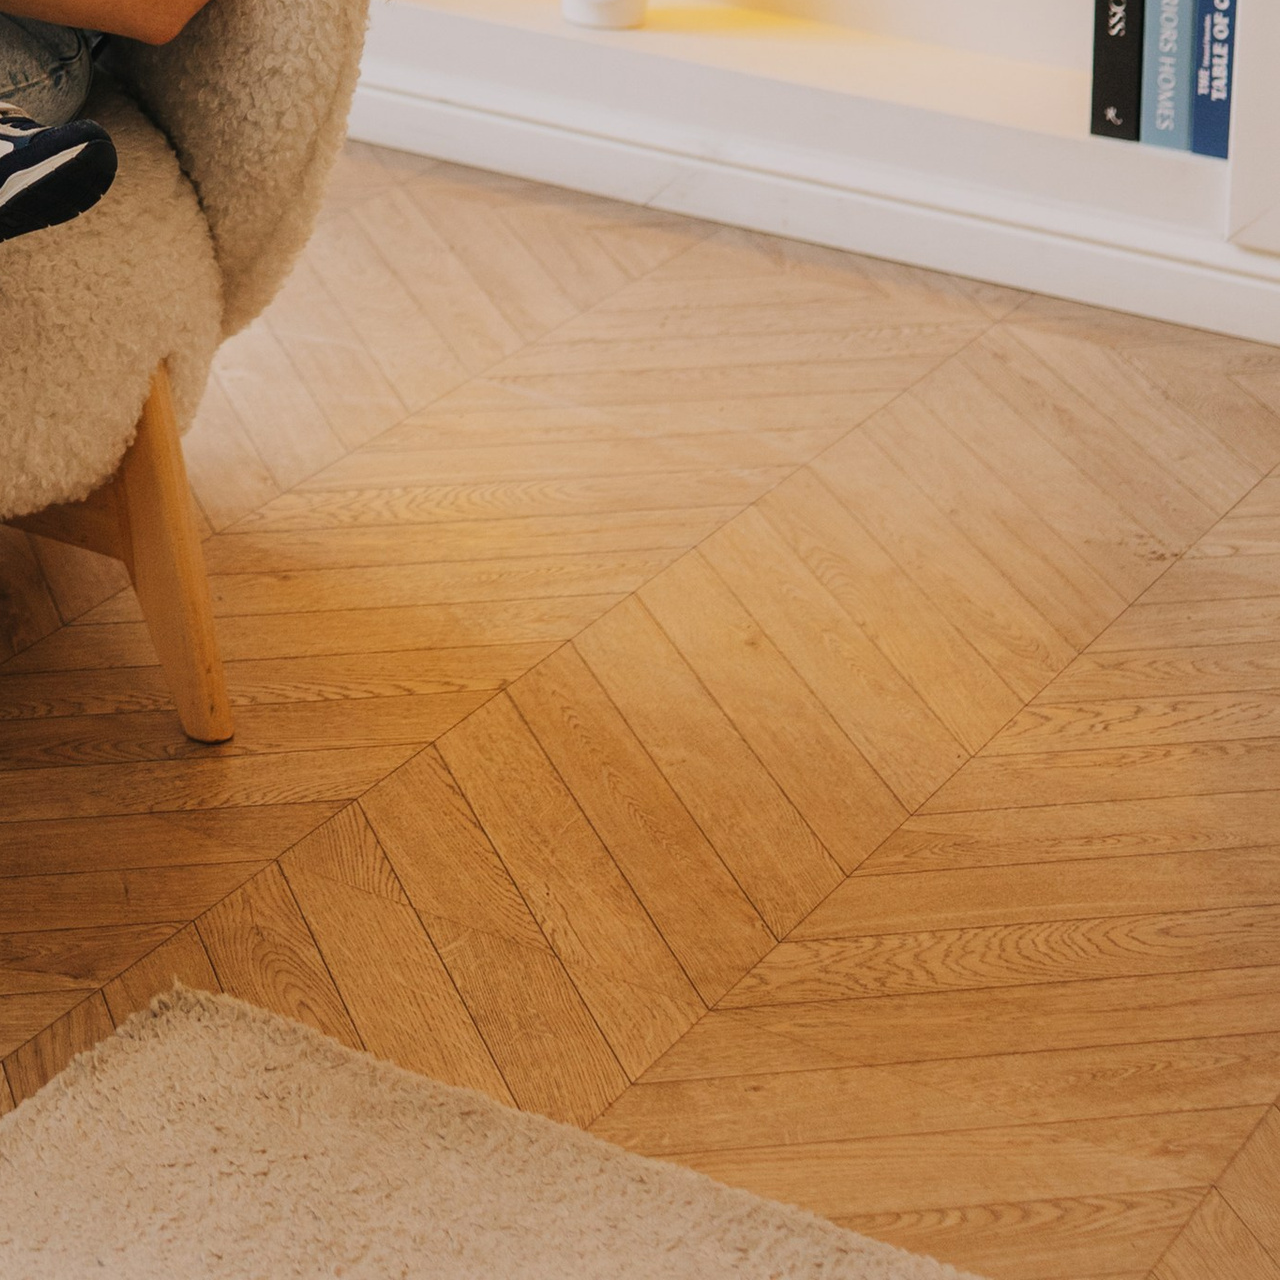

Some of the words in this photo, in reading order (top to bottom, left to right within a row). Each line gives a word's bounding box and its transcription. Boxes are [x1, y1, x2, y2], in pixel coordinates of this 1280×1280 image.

[1213, 12, 1229, 40] OF
[1156, 57, 1177, 131] HOMES
[1211, 43, 1229, 101] TABLE
